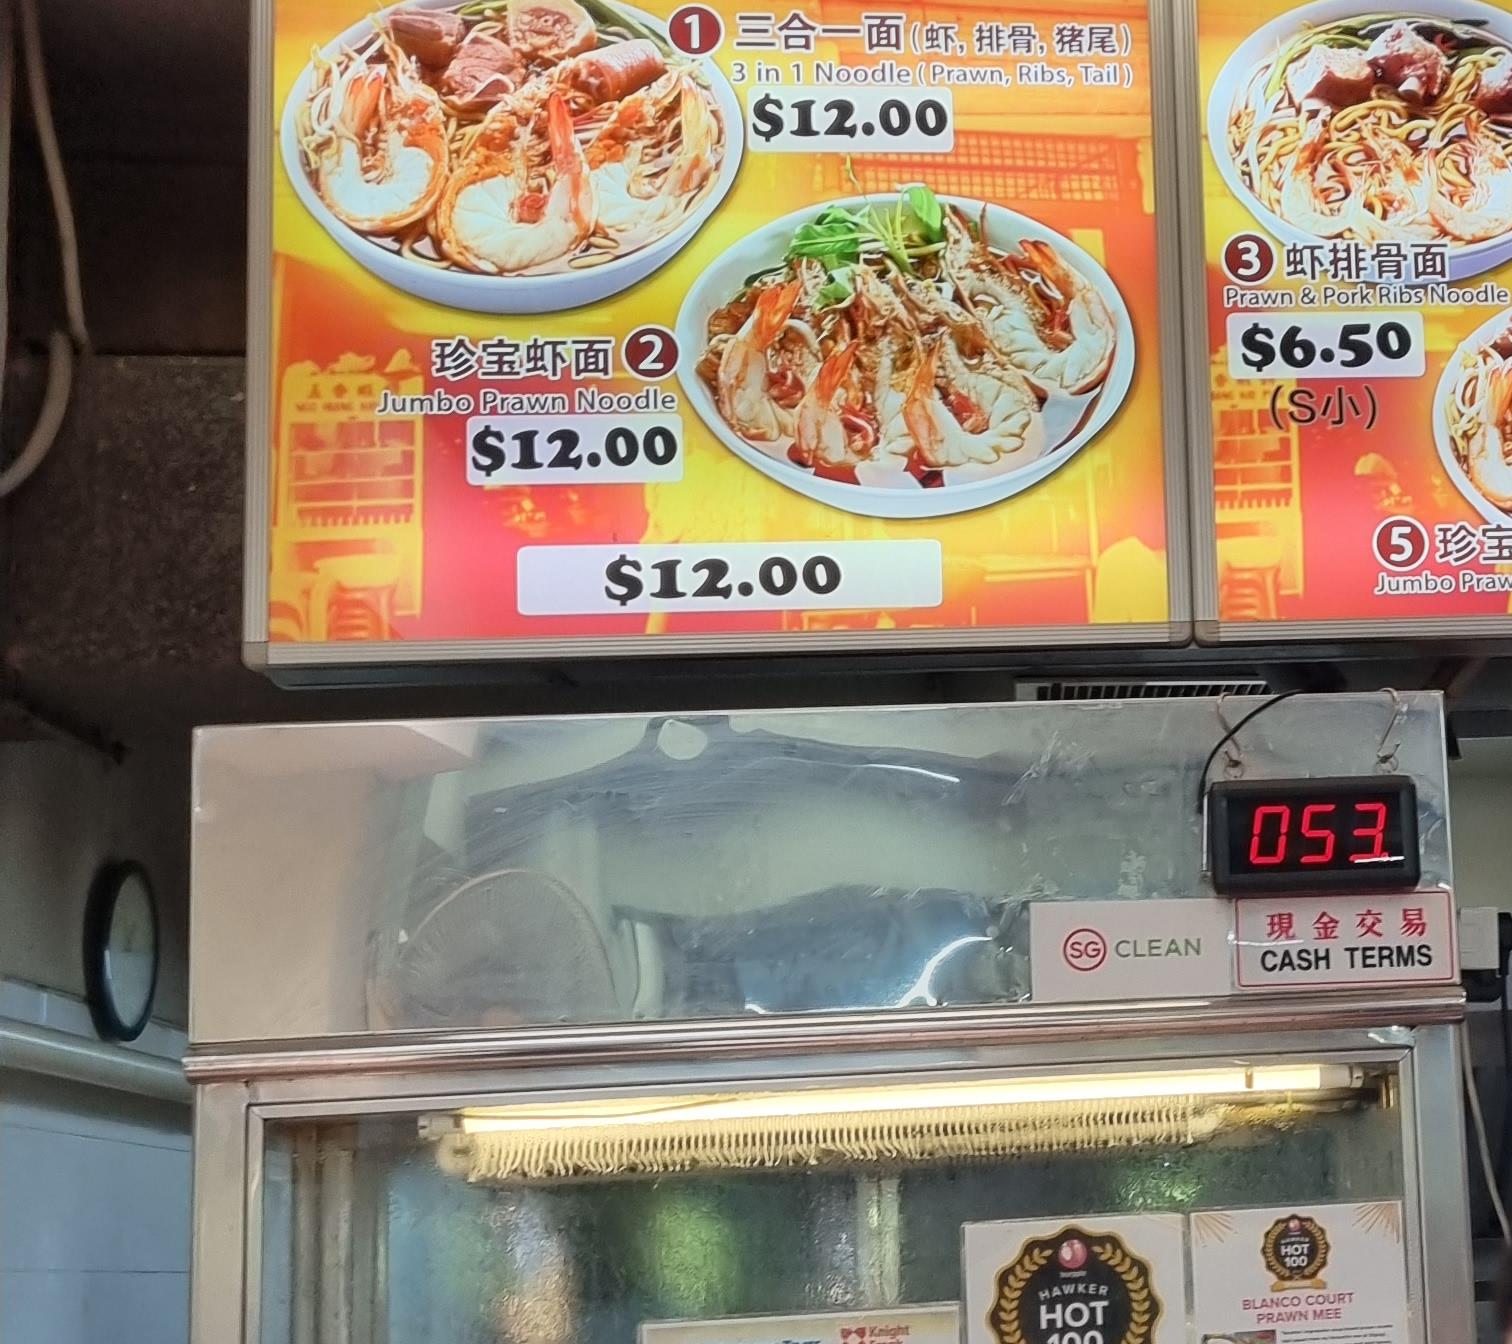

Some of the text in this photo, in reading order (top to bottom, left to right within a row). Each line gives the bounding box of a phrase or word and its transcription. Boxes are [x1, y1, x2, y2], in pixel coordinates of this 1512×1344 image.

[735, 13, 901, 51] 三合一面
[732, 63, 745, 83] 3
[757, 62, 780, 83] in
[793, 63, 802, 83] 1
[816, 62, 911, 84] Noodle
[1019, 62, 1073, 86] Ribs,
[752, 93, 949, 142] $12.00
[1285, 242, 1448, 280] 虾排骨面
[1226, 284, 1509, 306] Prawn & Pork Ribs Noodle
[434, 338, 612, 377] 珍宝虾面
[1241, 322, 1412, 373] $6.50
[378, 392, 471, 413] Jumbo
[482, 391, 566, 412] Prawn
[578, 389, 676, 411] Noodle
[1271, 385, 1377, 430] (S小)
[471, 424, 678, 477] $12.00
[603, 553, 842, 606] $12.00
[1376, 573, 1453, 593] Jumbo
[1249, 802, 1389, 865] 053
[1266, 907, 1428, 942] 現金交易
[1069, 937, 1201, 959] SG CLEAN
[1261, 944, 1432, 973] CASH TERMS
[1281, 1244, 1310, 1257] HOT
[1285, 1256, 1308, 1268] 100
[1038, 1283, 1109, 1301] HAWKER
[1242, 1292, 1355, 1311] BLANCO COURT
[1039, 1301, 1109, 1330] HOT
[1256, 1308, 1342, 1324] PRAWN MEE
[869, 1324, 910, 1338] Knight
